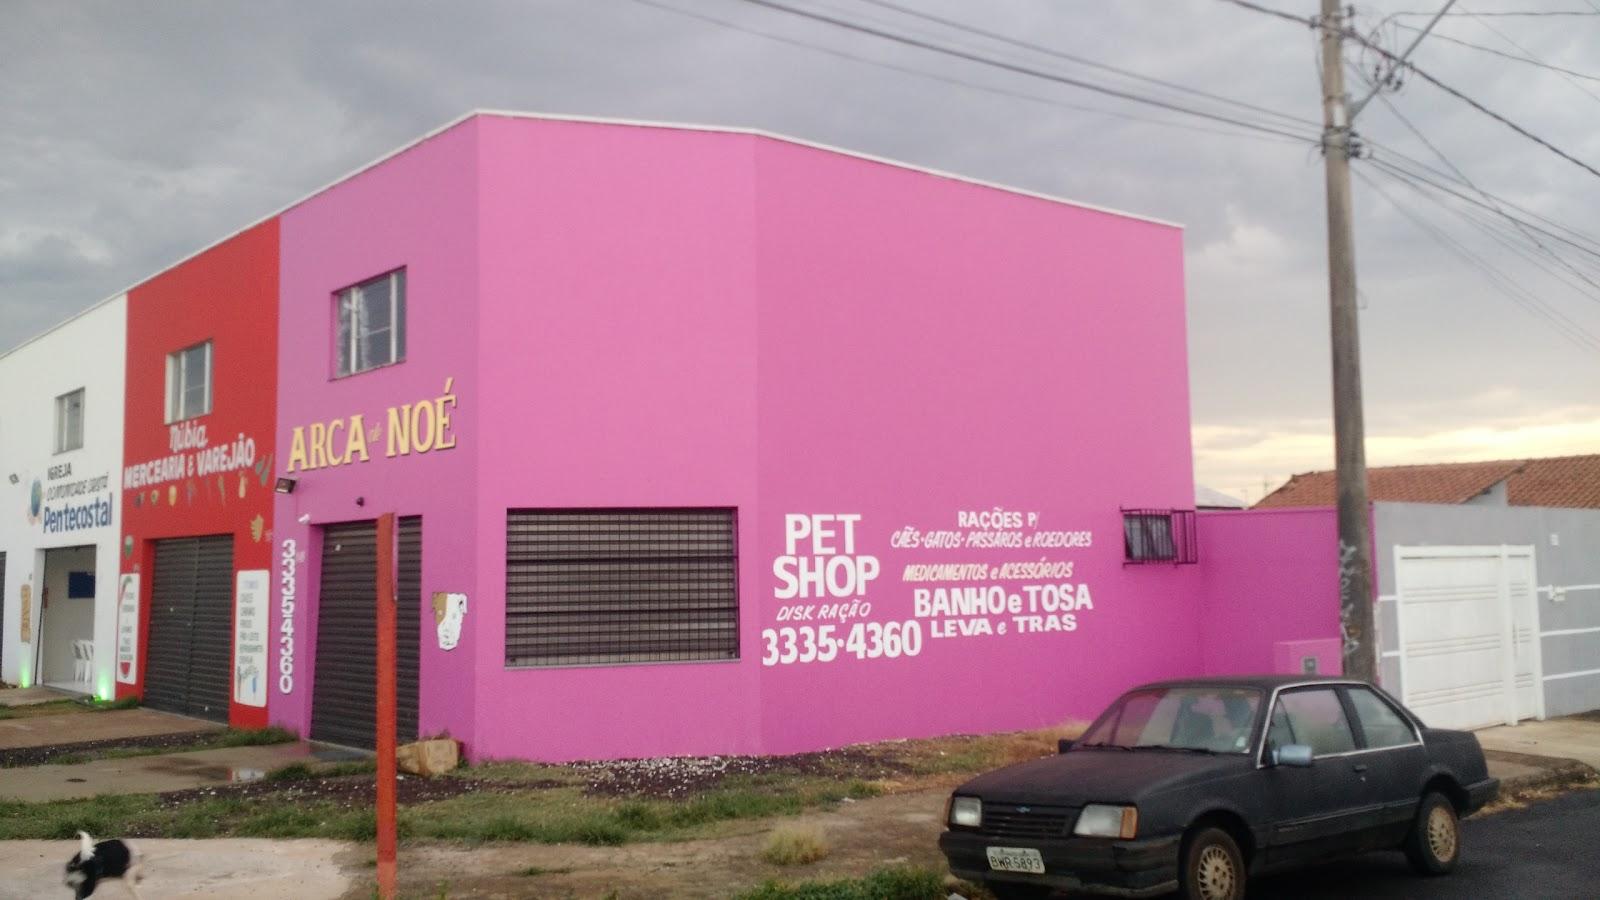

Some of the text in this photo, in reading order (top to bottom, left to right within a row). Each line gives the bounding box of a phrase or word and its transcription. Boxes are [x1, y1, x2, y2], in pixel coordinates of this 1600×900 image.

[287, 414, 370, 473] ARCA
[386, 377, 457, 457] NOÉ
[47, 462, 72, 480] IGREJA
[124, 454, 186, 489] MERCEARIA
[196, 432, 256, 476] VAREJÃO
[43, 492, 113, 534] Pentecostal
[958, 507, 1023, 532] RAÇÕES
[785, 513, 862, 555] PET
[1032, 531, 1092, 548] ROEDORES
[773, 555, 880, 599] SHOP
[902, 564, 988, 582] MEDICAMENTOS
[999, 557, 1074, 580] ACESSÓRIOS
[776, 599, 872, 623] DISK RAÇÃO
[913, 585, 1006, 618] BANHO
[1022, 583, 1094, 613] TOSA
[930, 618, 993, 638] LEVA
[1012, 614, 1078, 634] TRAS
